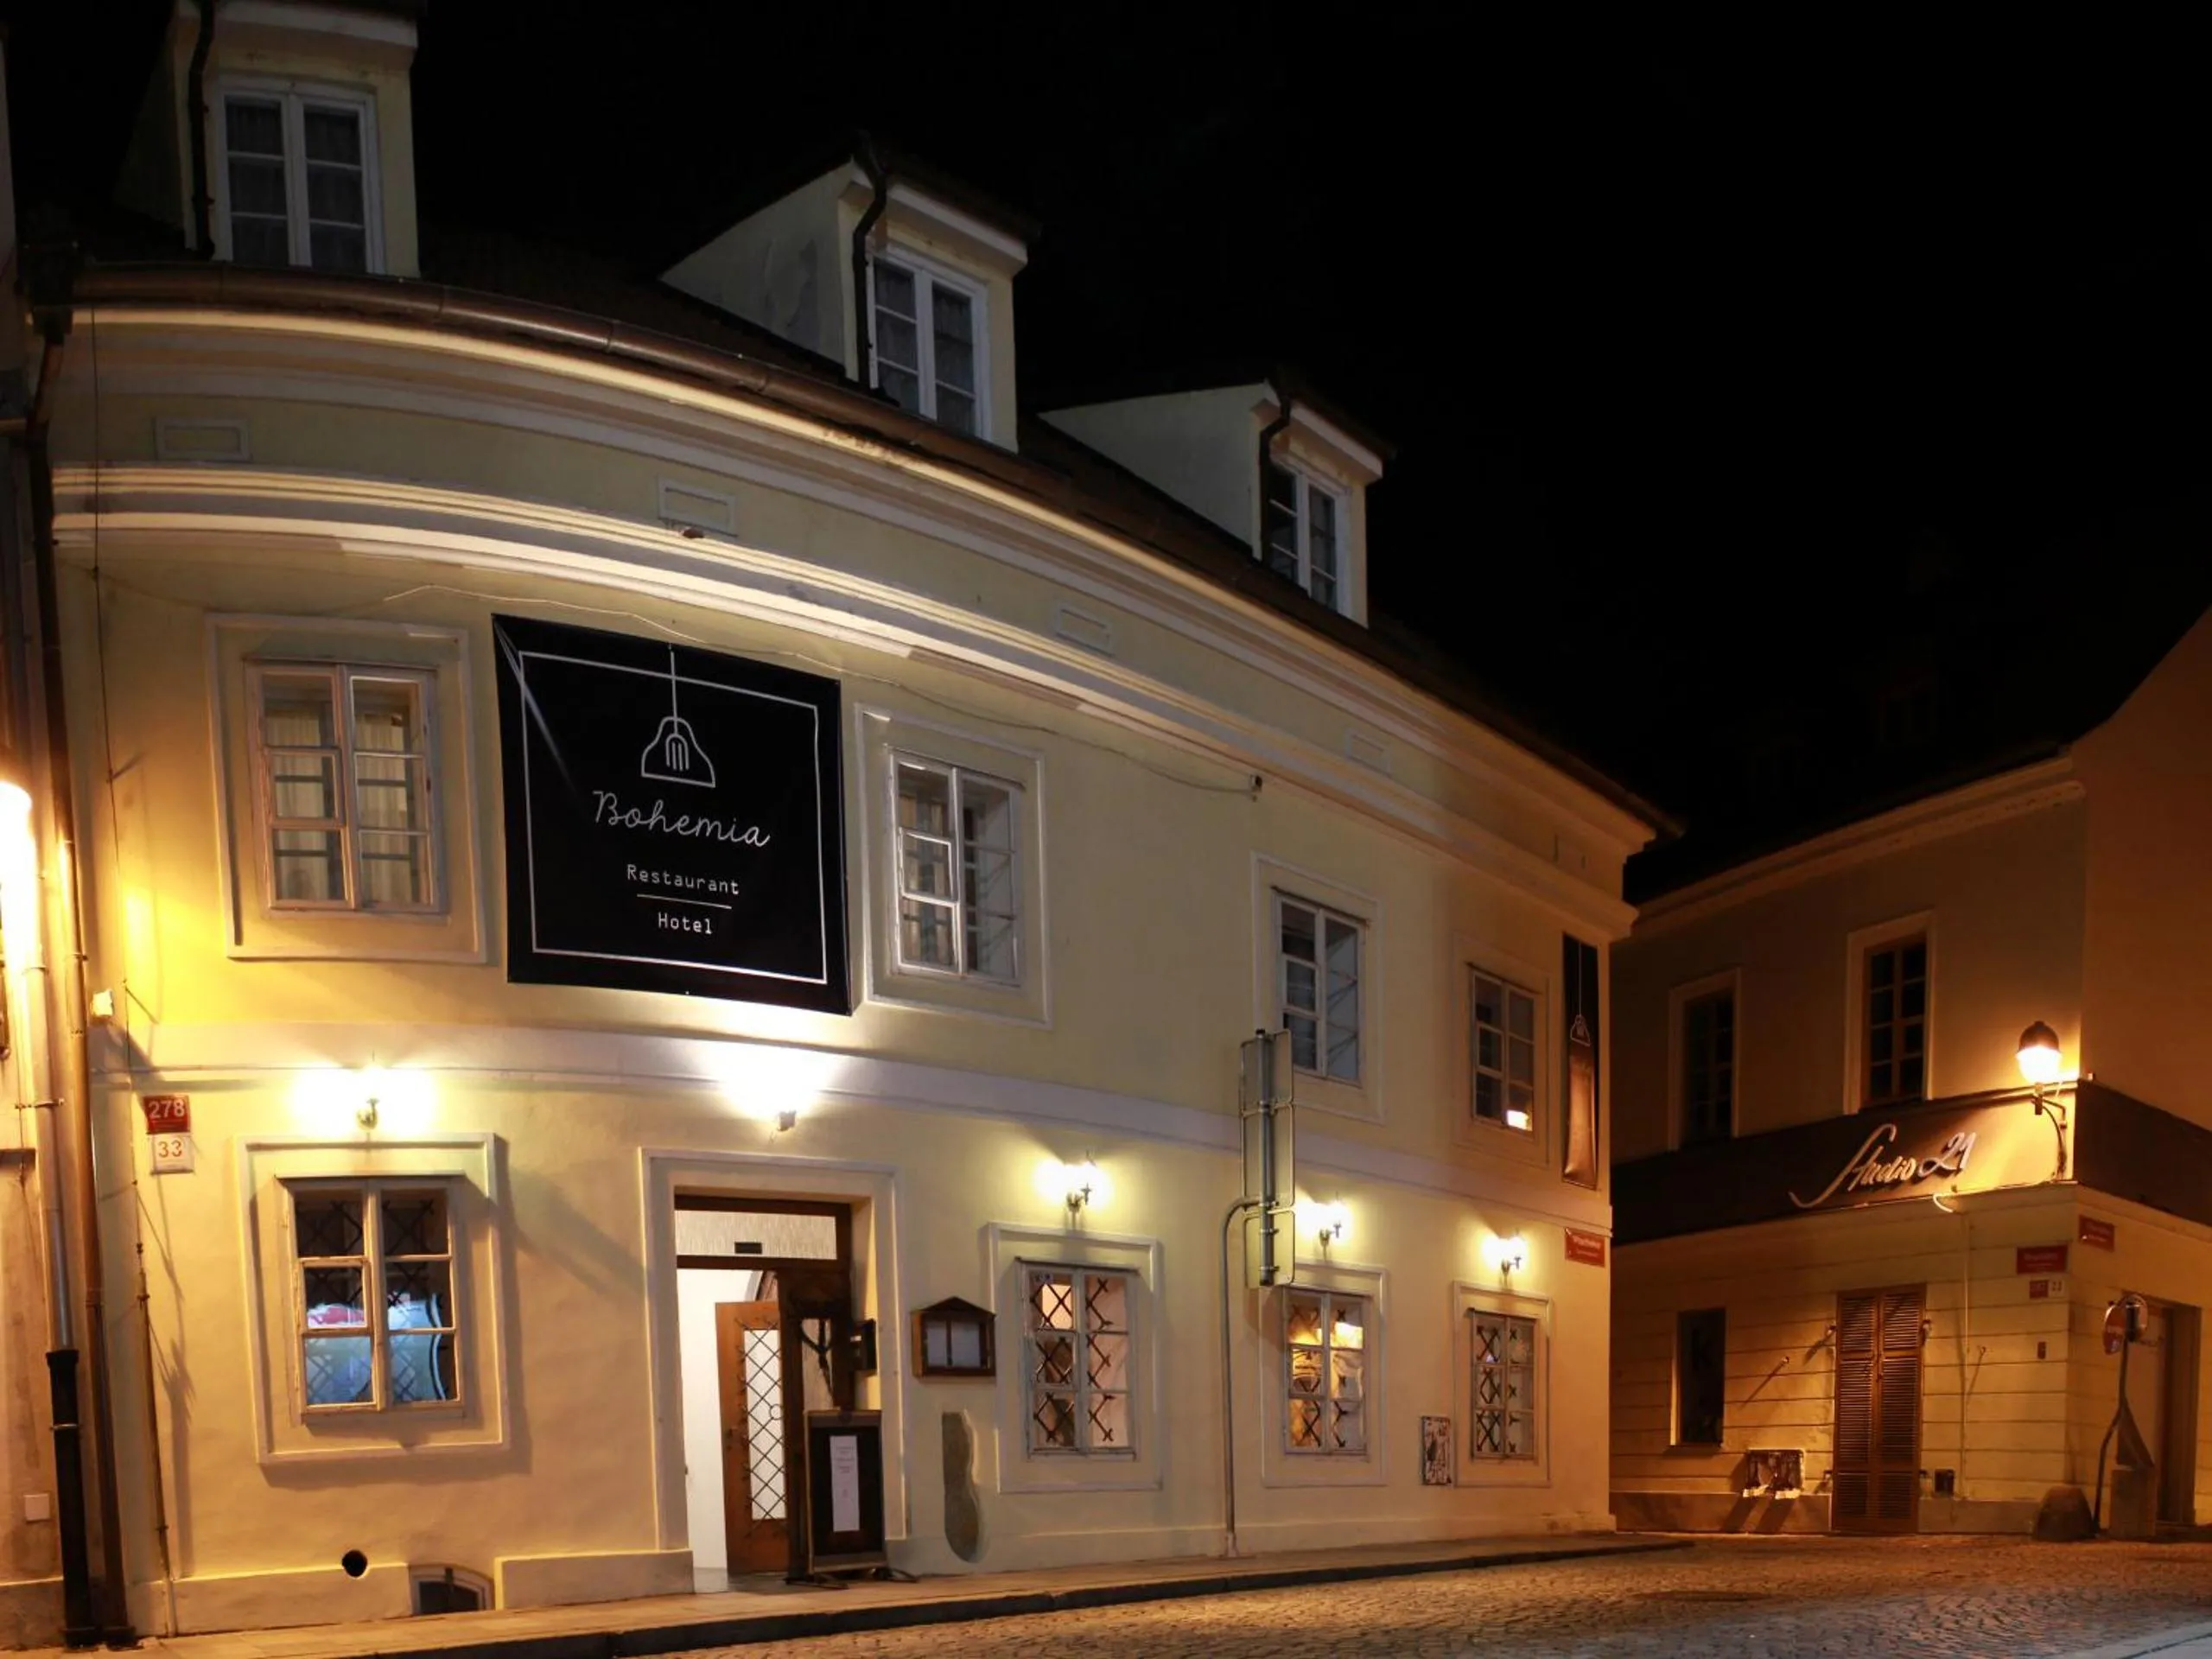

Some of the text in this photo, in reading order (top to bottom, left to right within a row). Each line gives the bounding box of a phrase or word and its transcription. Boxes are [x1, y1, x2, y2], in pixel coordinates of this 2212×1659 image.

[592, 790, 770, 848] Bohemia
[626, 864, 740, 895] Restaurant
[658, 912, 714, 935] Hotel
[148, 1098, 185, 1119] 278
[158, 1140, 182, 1159] 33
[1788, 1123, 1916, 1208] Studio
